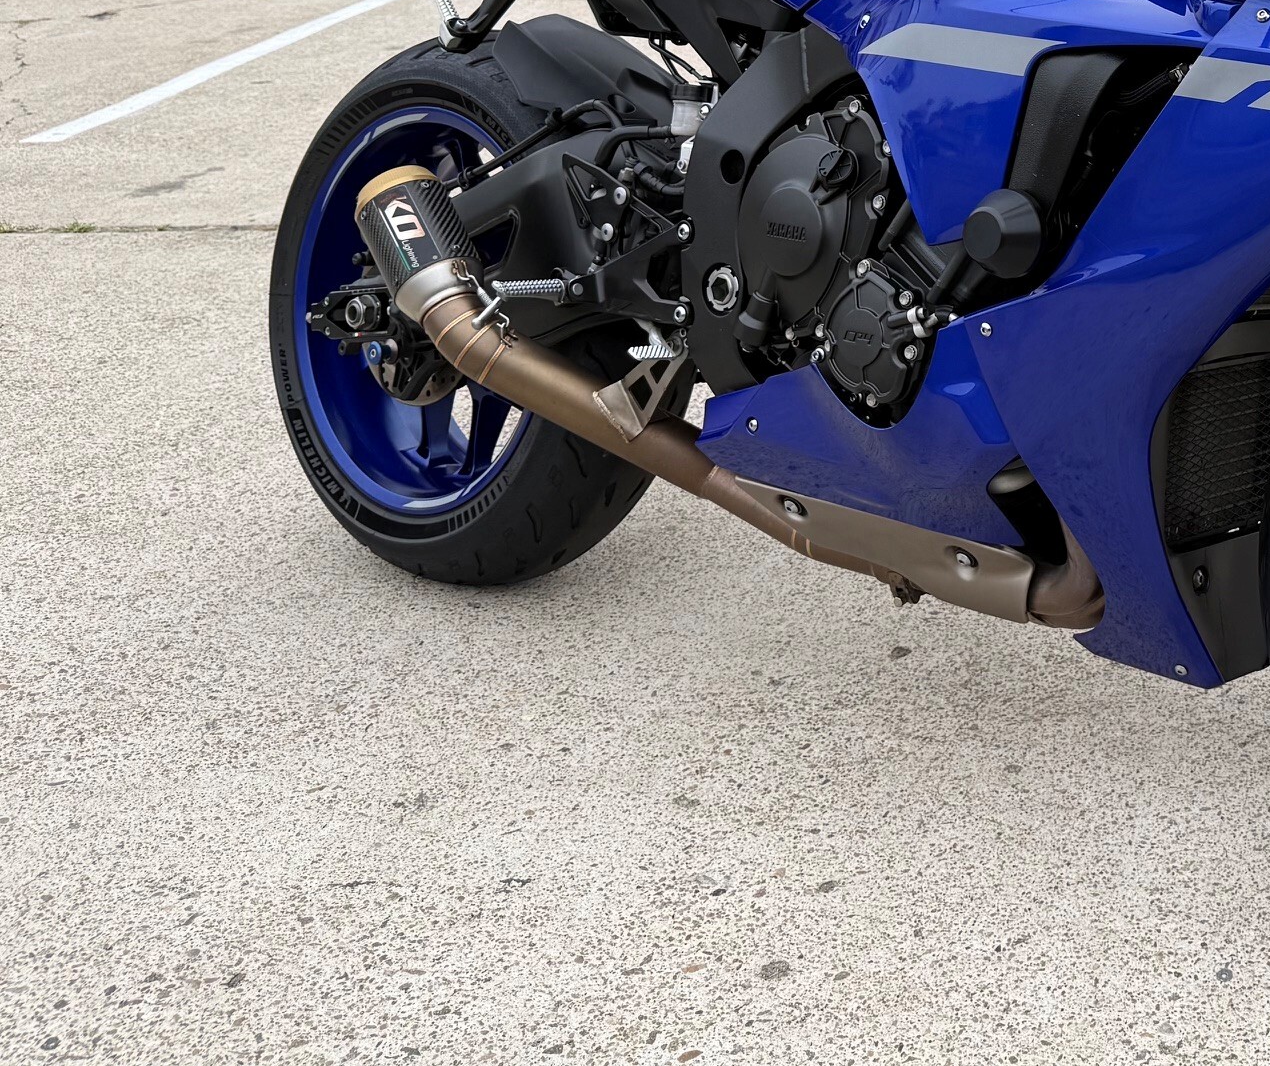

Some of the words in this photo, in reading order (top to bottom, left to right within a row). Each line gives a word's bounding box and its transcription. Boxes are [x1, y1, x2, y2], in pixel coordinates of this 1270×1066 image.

[767, 221, 806, 243] YAMAHA
[401, 239, 420, 268] Lightning
[281, 348, 296, 404] POWER
[292, 418, 344, 495] MICHELIN
